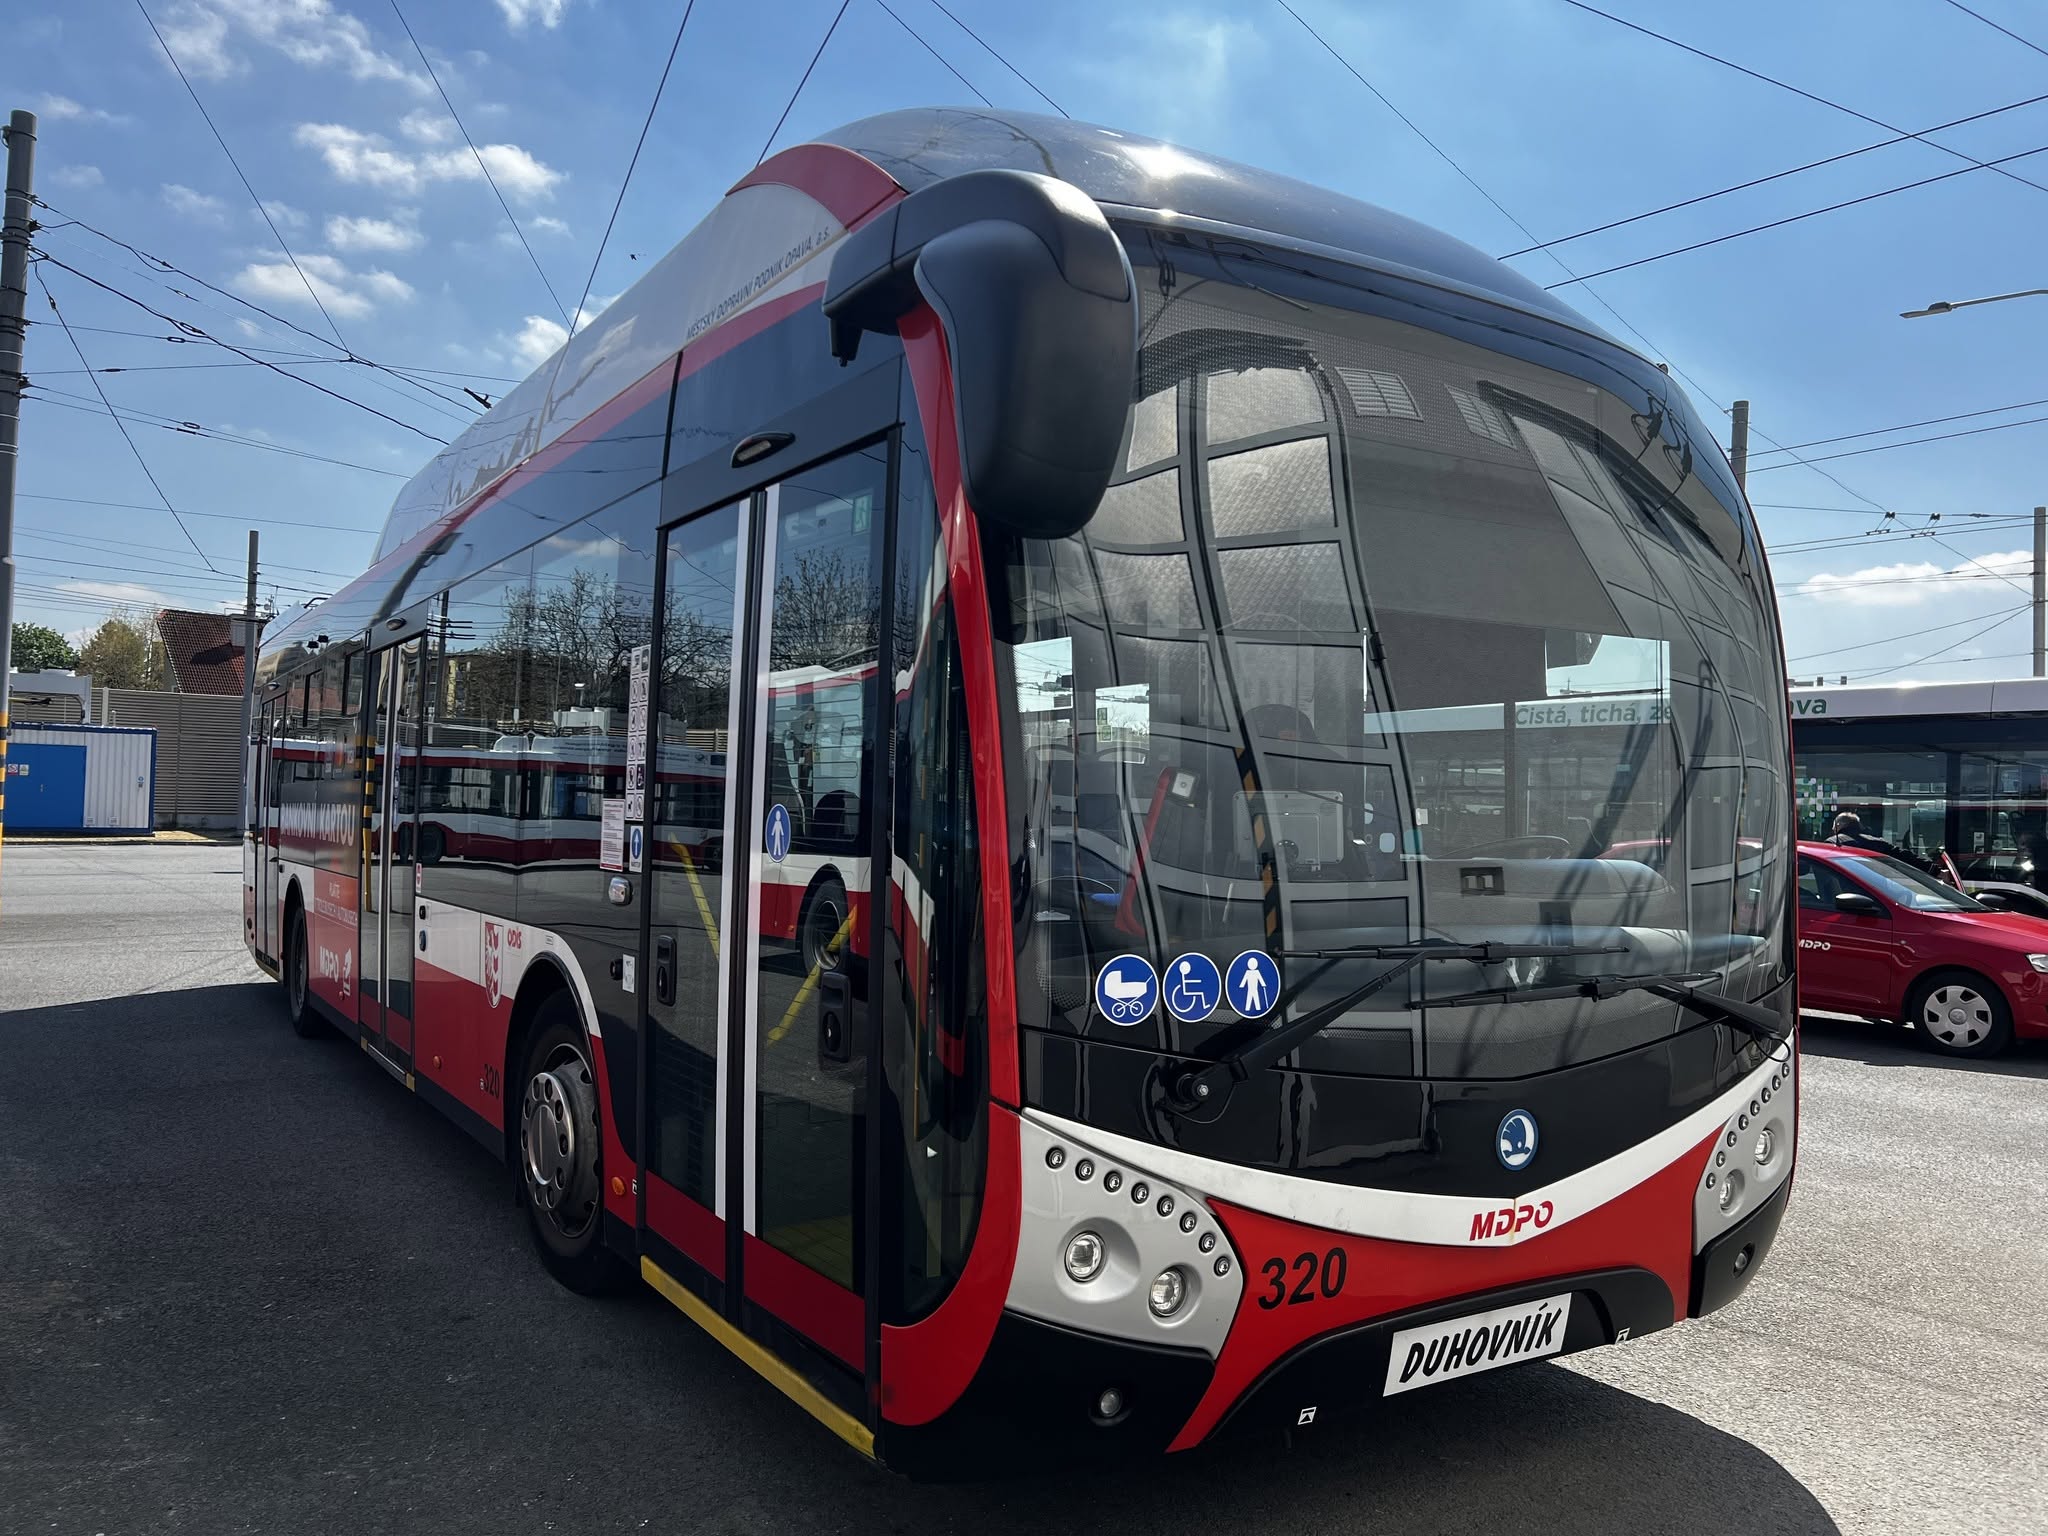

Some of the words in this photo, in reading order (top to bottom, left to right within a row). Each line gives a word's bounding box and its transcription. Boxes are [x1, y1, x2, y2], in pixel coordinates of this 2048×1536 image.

[753, 257, 785, 291] PODNIK
[1515, 703, 1572, 726] Čistá,
[1580, 702, 1641, 725] tichá,
[1790, 698, 1827, 716] va
[319, 803, 356, 847] KARTOU
[484, 1063, 500, 1099] 320
[1468, 1200, 1554, 1242] MDPO
[1257, 1246, 1348, 1311] 320
[1398, 1302, 1563, 1384] DUHOVNÍK
